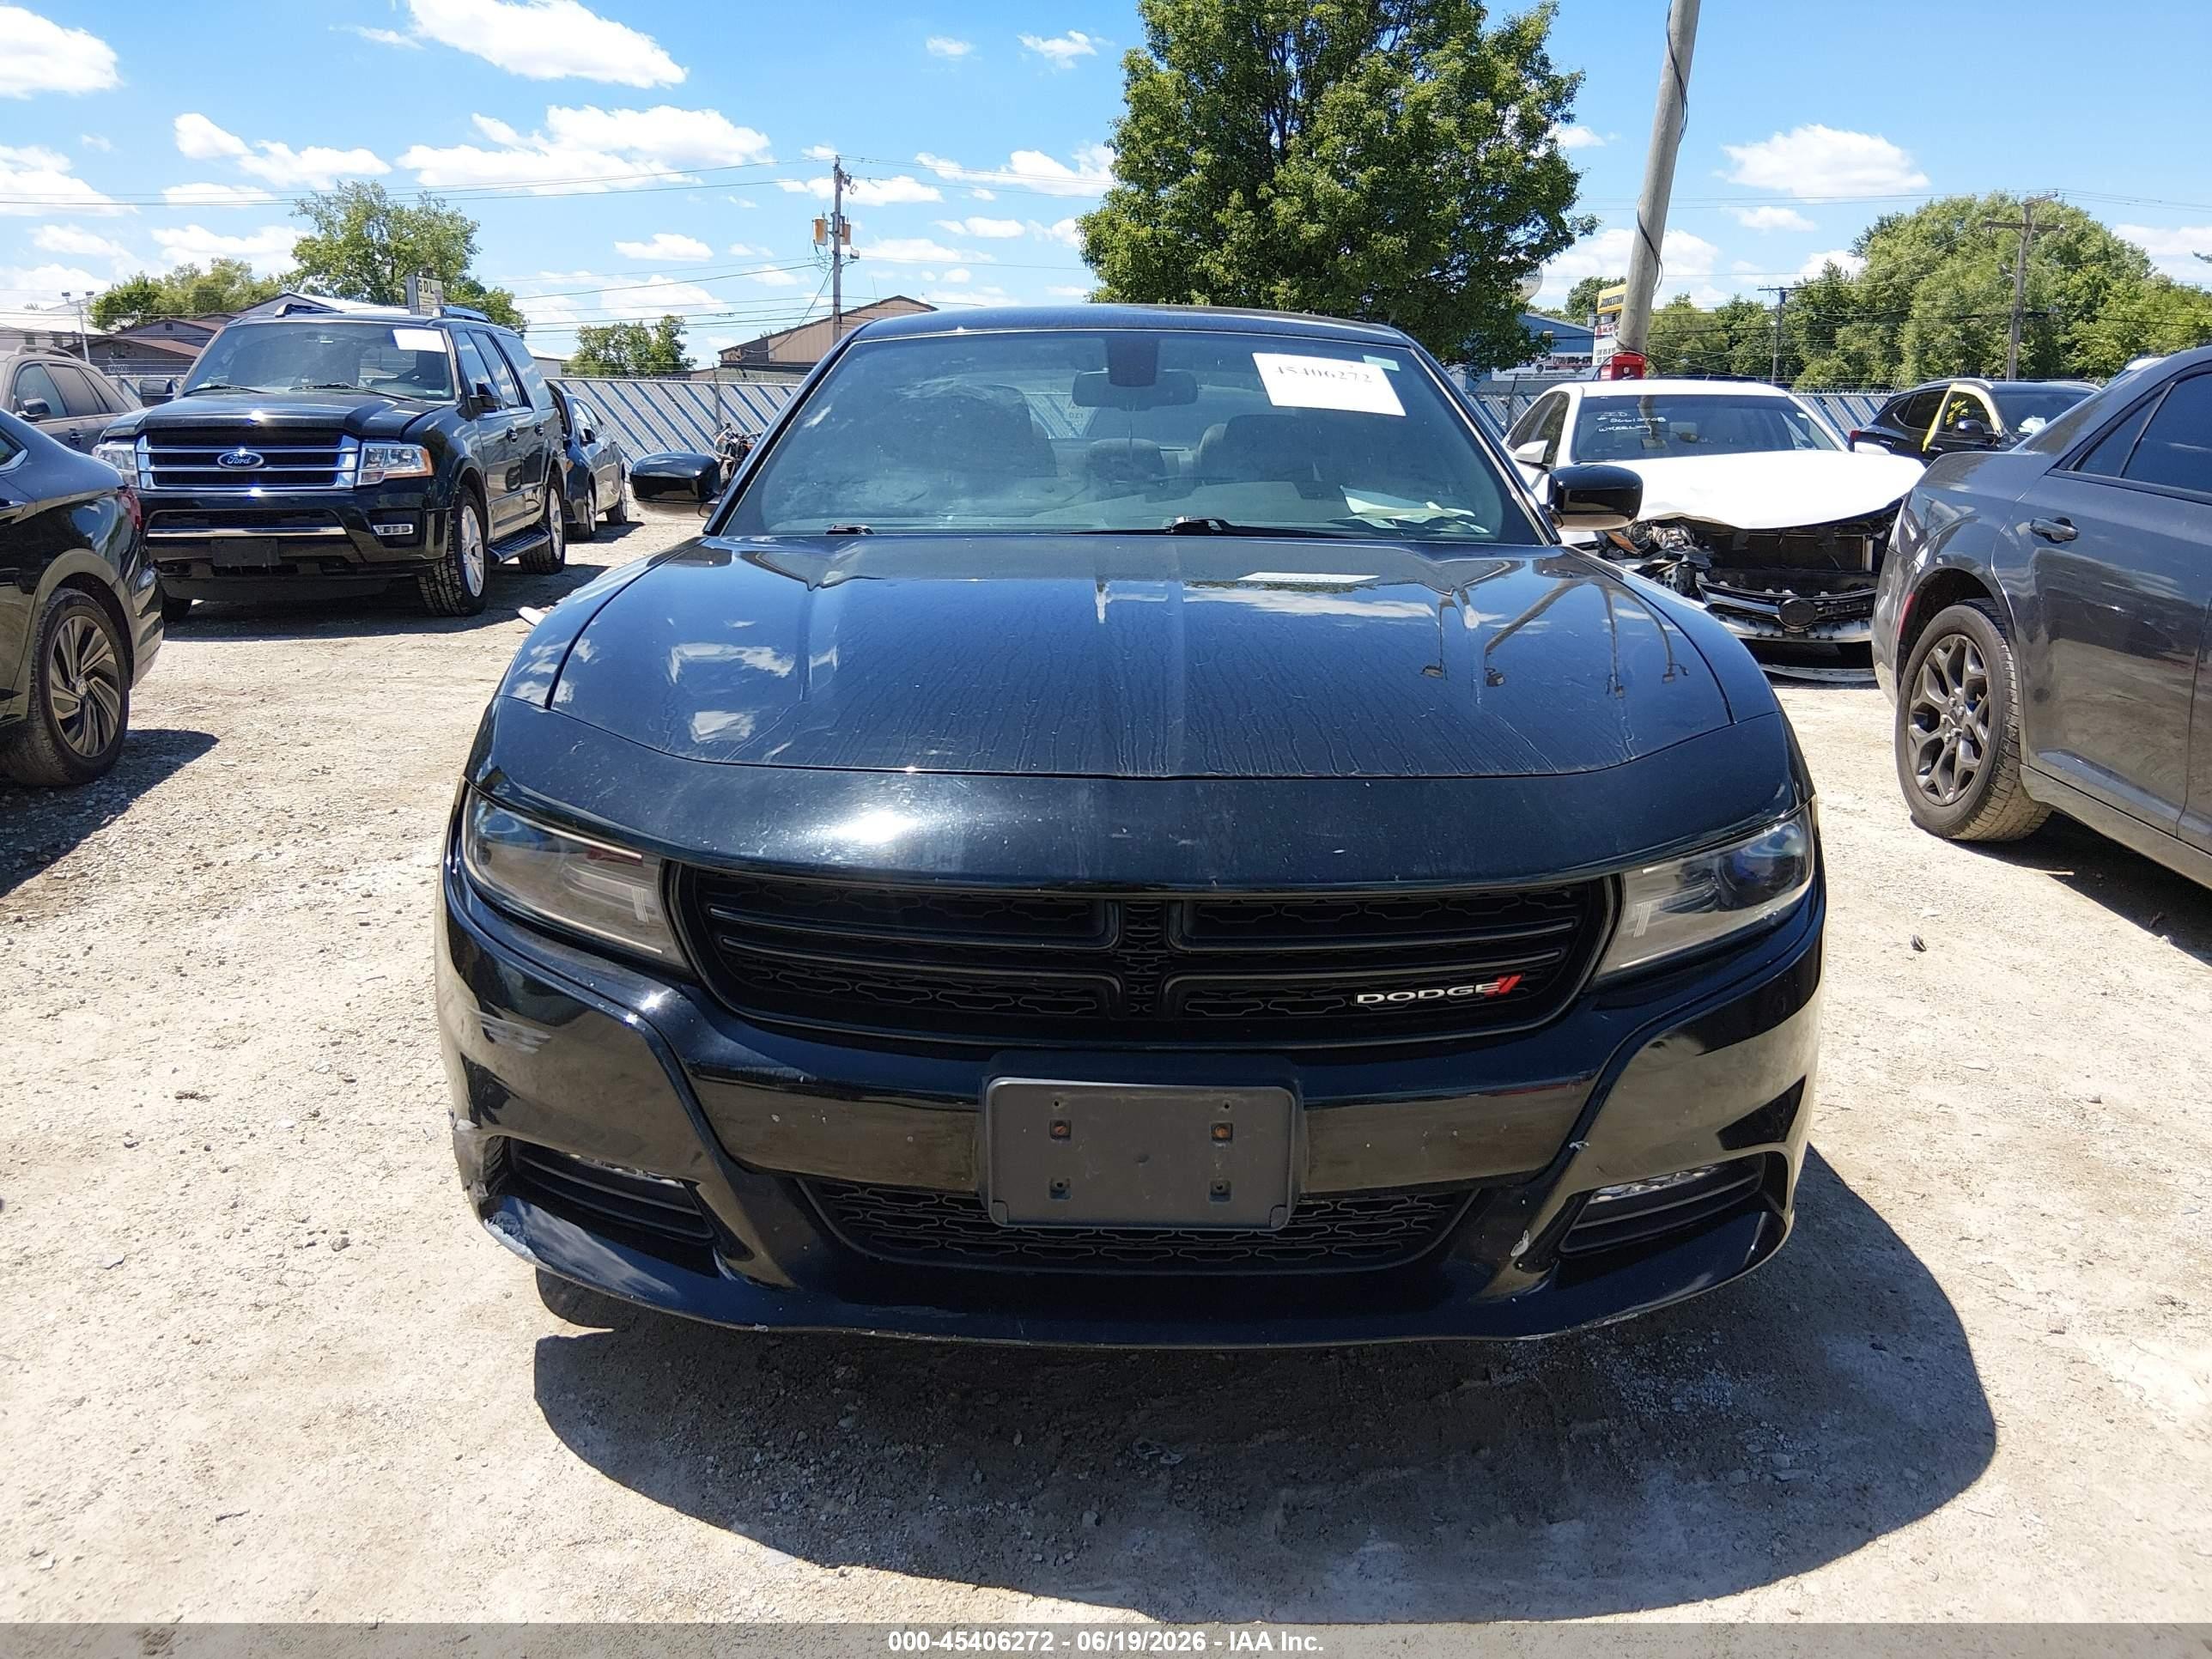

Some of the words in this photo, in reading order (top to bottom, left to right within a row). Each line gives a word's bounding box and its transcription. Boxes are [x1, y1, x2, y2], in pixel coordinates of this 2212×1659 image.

[416, 279, 434, 295] GDL
[227, 454, 252, 465] Ford
[1356, 981, 1502, 1005] DODGE
